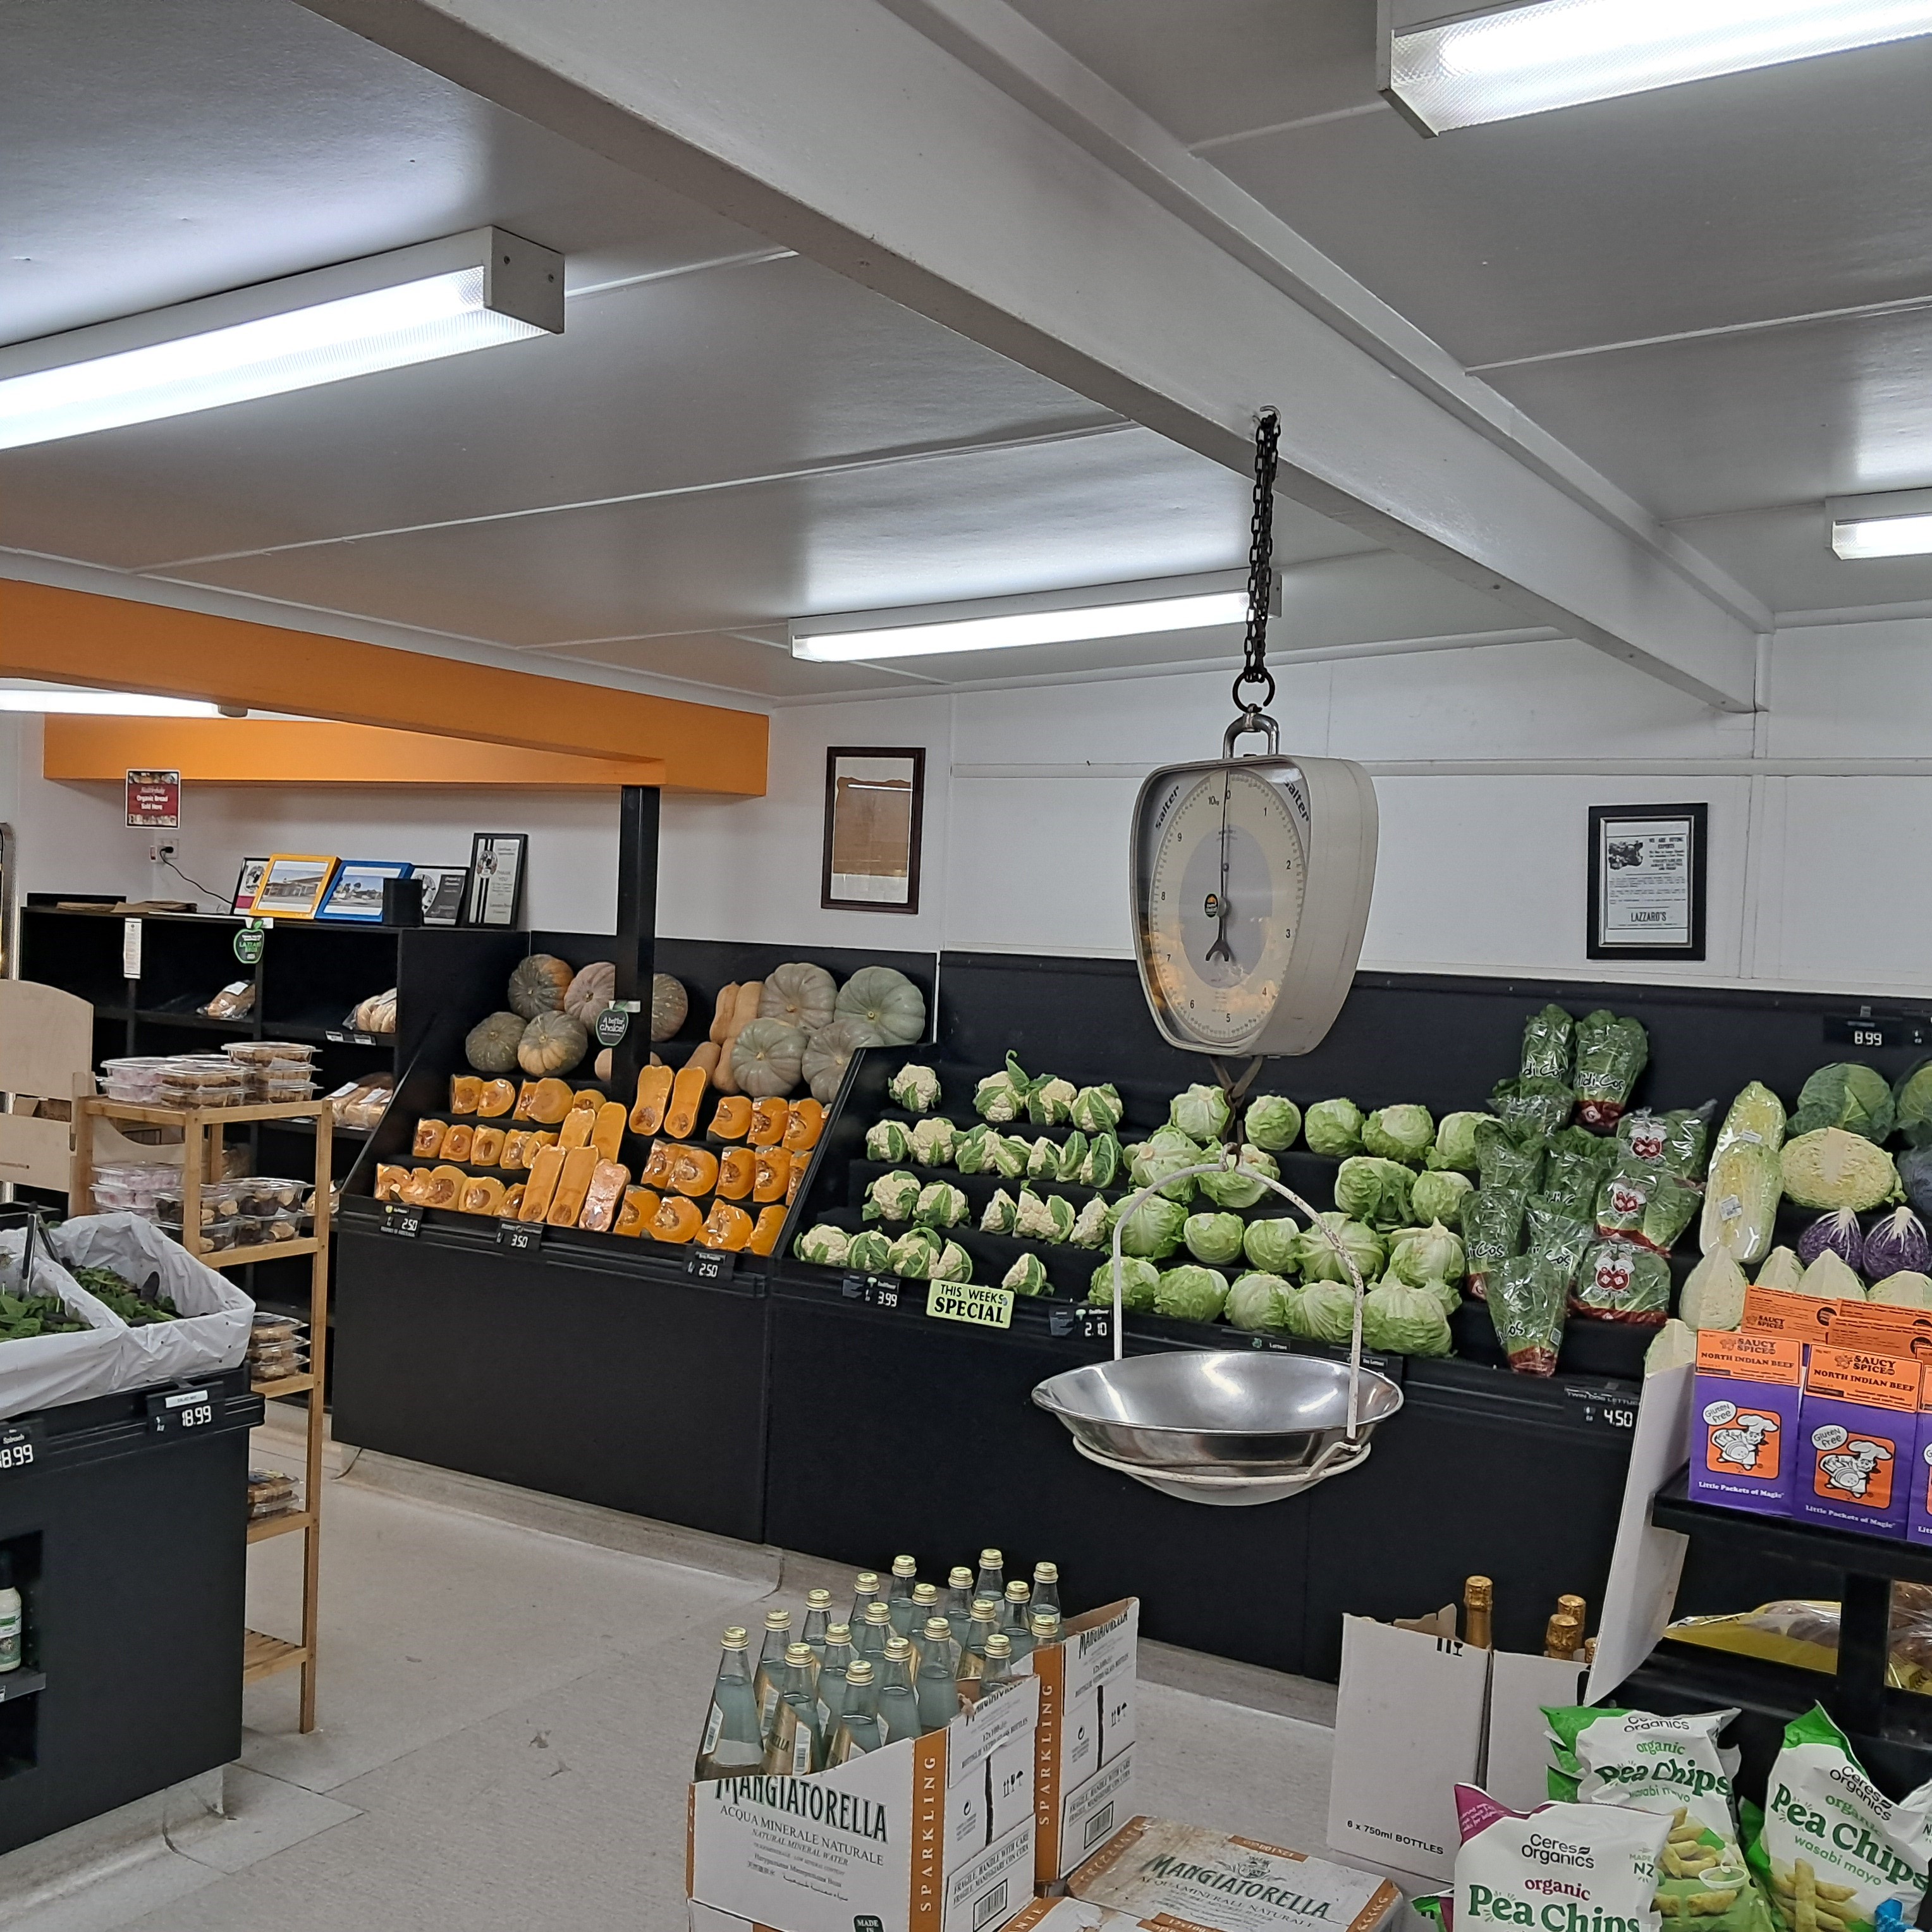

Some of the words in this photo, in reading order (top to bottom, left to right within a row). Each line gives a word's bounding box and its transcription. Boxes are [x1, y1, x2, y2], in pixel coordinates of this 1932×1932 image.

[1155, 785, 1179, 830] salter
[1177, 832, 1183, 842] 9
[1286, 860, 1292, 871] 2
[1161, 891, 1166, 901] 8
[1630, 912, 1667, 922] LAZZARO'S
[1285, 928, 1291, 939] 3
[1166, 954, 1171, 963] 7
[1262, 987, 1267, 996] 4
[1190, 1000, 1195, 1009] 6
[1226, 1013, 1231, 1023] 5
[1854, 1030, 1882, 1046] 8.99
[1598, 1074, 1625, 1091] Cos
[1476, 1241, 1505, 1258] Cos
[877, 1290, 898, 1307] 3.99
[941, 1284, 962, 1297] THIS
[969, 1288, 1004, 1305] WEEKS
[934, 1296, 1004, 1324] SPECIAL
[1758, 1314, 1785, 1324] SAUCY
[1737, 1338, 1776, 1348] SAUCY
[1737, 1345, 1769, 1354] SPICE
[1701, 1352, 1732, 1362] NORTH
[1735, 1355, 1769, 1366] INDIAN
[1771, 1359, 1795, 1369] BEEF
[1853, 1362, 1887, 1375] SPICE
[1854, 1355, 1897, 1369] SAUCY
[1813, 1369, 1848, 1381] NORTH
[1850, 1374, 1888, 1387] INDIAN
[1889, 1381, 1916, 1392] BEEF
[1607, 1398, 1639, 1406] LETTUC
[181, 1405, 212, 1428] 18.99
[1604, 1409, 1633, 1428] 4.50
[1712, 1410, 1732, 1423] free
[1821, 1434, 1843, 1449] free
[1698, 1481, 1720, 1491] Little
[1720, 1484, 1750, 1495] Packets
[1751, 1488, 1759, 1496] of
[1760, 1489, 1782, 1499] Magic
[1806, 1504, 1827, 1516] Little
[1828, 1509, 1859, 1522] Packets
[1860, 1515, 1869, 1524] of
[1869, 1517, 1893, 1529] Magic
[1037, 1682, 1053, 1826] SPARKLING
[1636, 1740, 1686, 1756] organic
[1594, 1764, 1649, 1783] Pea
[1651, 1758, 1730, 1797] Chips
[1841, 1765, 1883, 1802] Ceres
[1662, 1787, 1690, 1802] myo
[1829, 1768, 1892, 1821] Organics
[714, 1776, 889, 1845] MANGIATORELLA
[720, 1805, 758, 1826] ACQUA
[761, 1816, 819, 1845] MINERALE
[822, 1836, 884, 1866] NATURALE
[919, 1755, 937, 1912] SPARKLING
[1347, 1819, 1353, 1828] 6
[1364, 1825, 1393, 1840] 750ml
[1395, 1834, 1445, 1856] BOTTLES
[1770, 1782, 1826, 1839] Pea
[1832, 1822, 1929, 1893] Chips
[752, 1828, 785, 1847] NATURAL
[788, 1839, 821, 1857] MINERAL
[823, 1851, 849, 1866] WATER
[1001, 1842, 1016, 1857] WITH
[1015, 1832, 1030, 1849] CARE
[1529, 1833, 1578, 1854] Ceres
[1521, 1844, 1595, 1869] Organics
[1794, 1835, 1843, 1866] wasabi
[1843, 1861, 1882, 1886] mayo
[1633, 1862, 1655, 1879] NZ
[1147, 1854, 1331, 1919] MANGIATORELLA
[1524, 1878, 1591, 1902] organic
[1467, 1883, 1536, 1928] Pea
[1541, 1902, 1640, 1932] Chips
[857, 1918, 879, 1927] MADE
